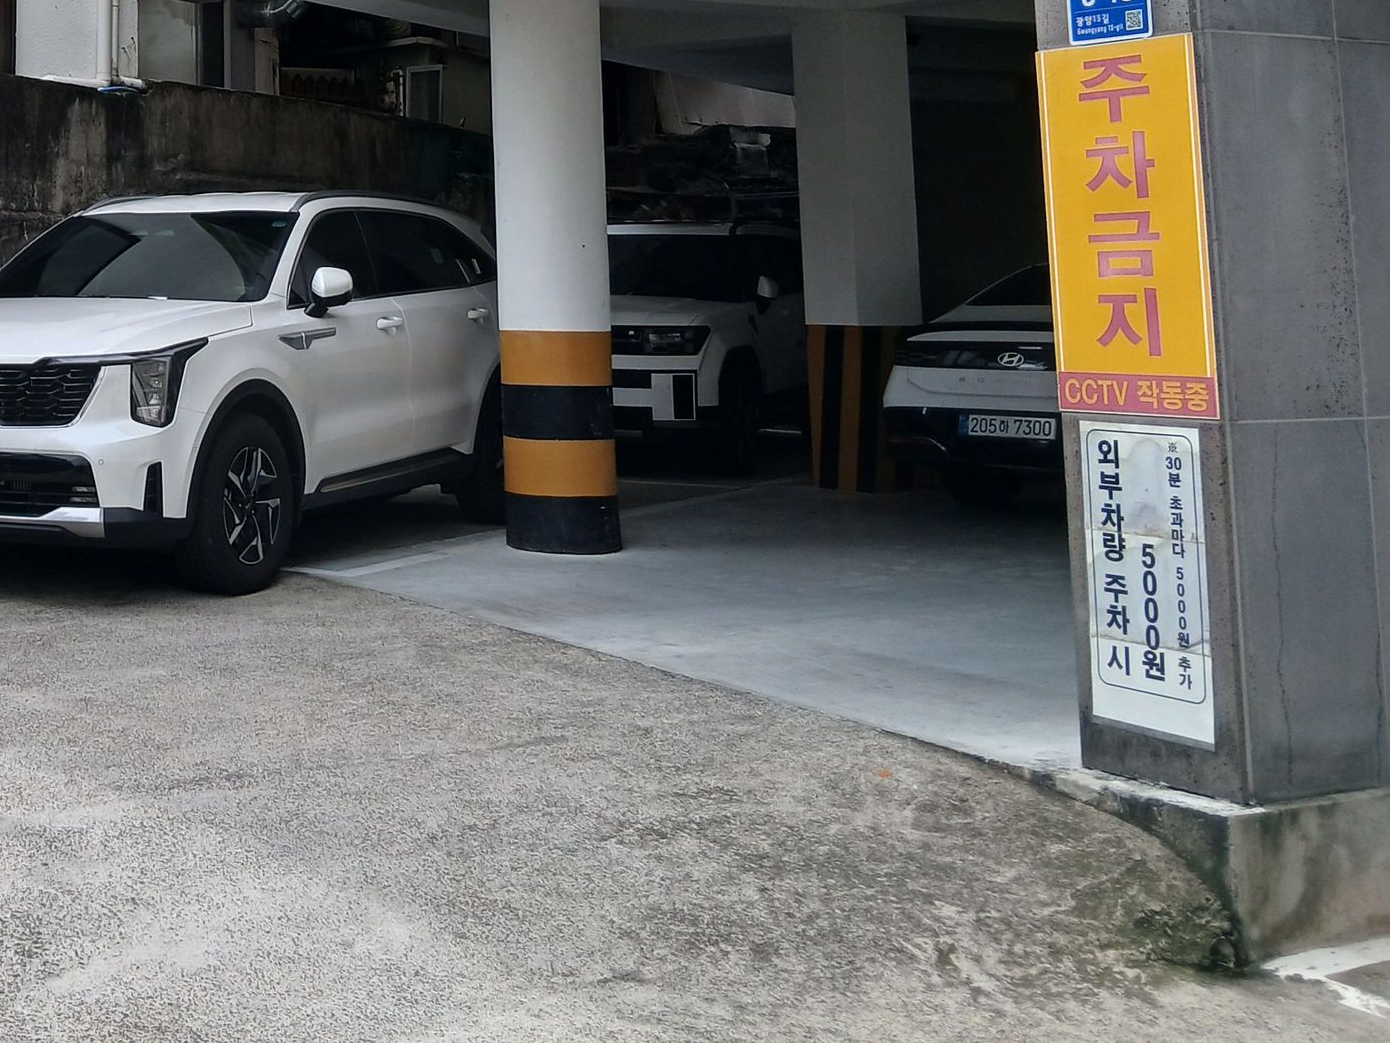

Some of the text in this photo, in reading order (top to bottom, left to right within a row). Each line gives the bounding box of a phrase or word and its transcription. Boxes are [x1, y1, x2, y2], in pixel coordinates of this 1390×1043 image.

[1078, 54, 1162, 358] 주차금지
[1013, 419, 1052, 437] 7300
[1064, 377, 1210, 413] CCTV 작동중
[1097, 439, 1131, 677] 외부차량 주차 시
[1168, 495, 1186, 559] 초과마다
[1141, 543, 1166, 682] 5000원
[1175, 566, 1190, 648] 5000원
[1178, 655, 1193, 690] 추가
